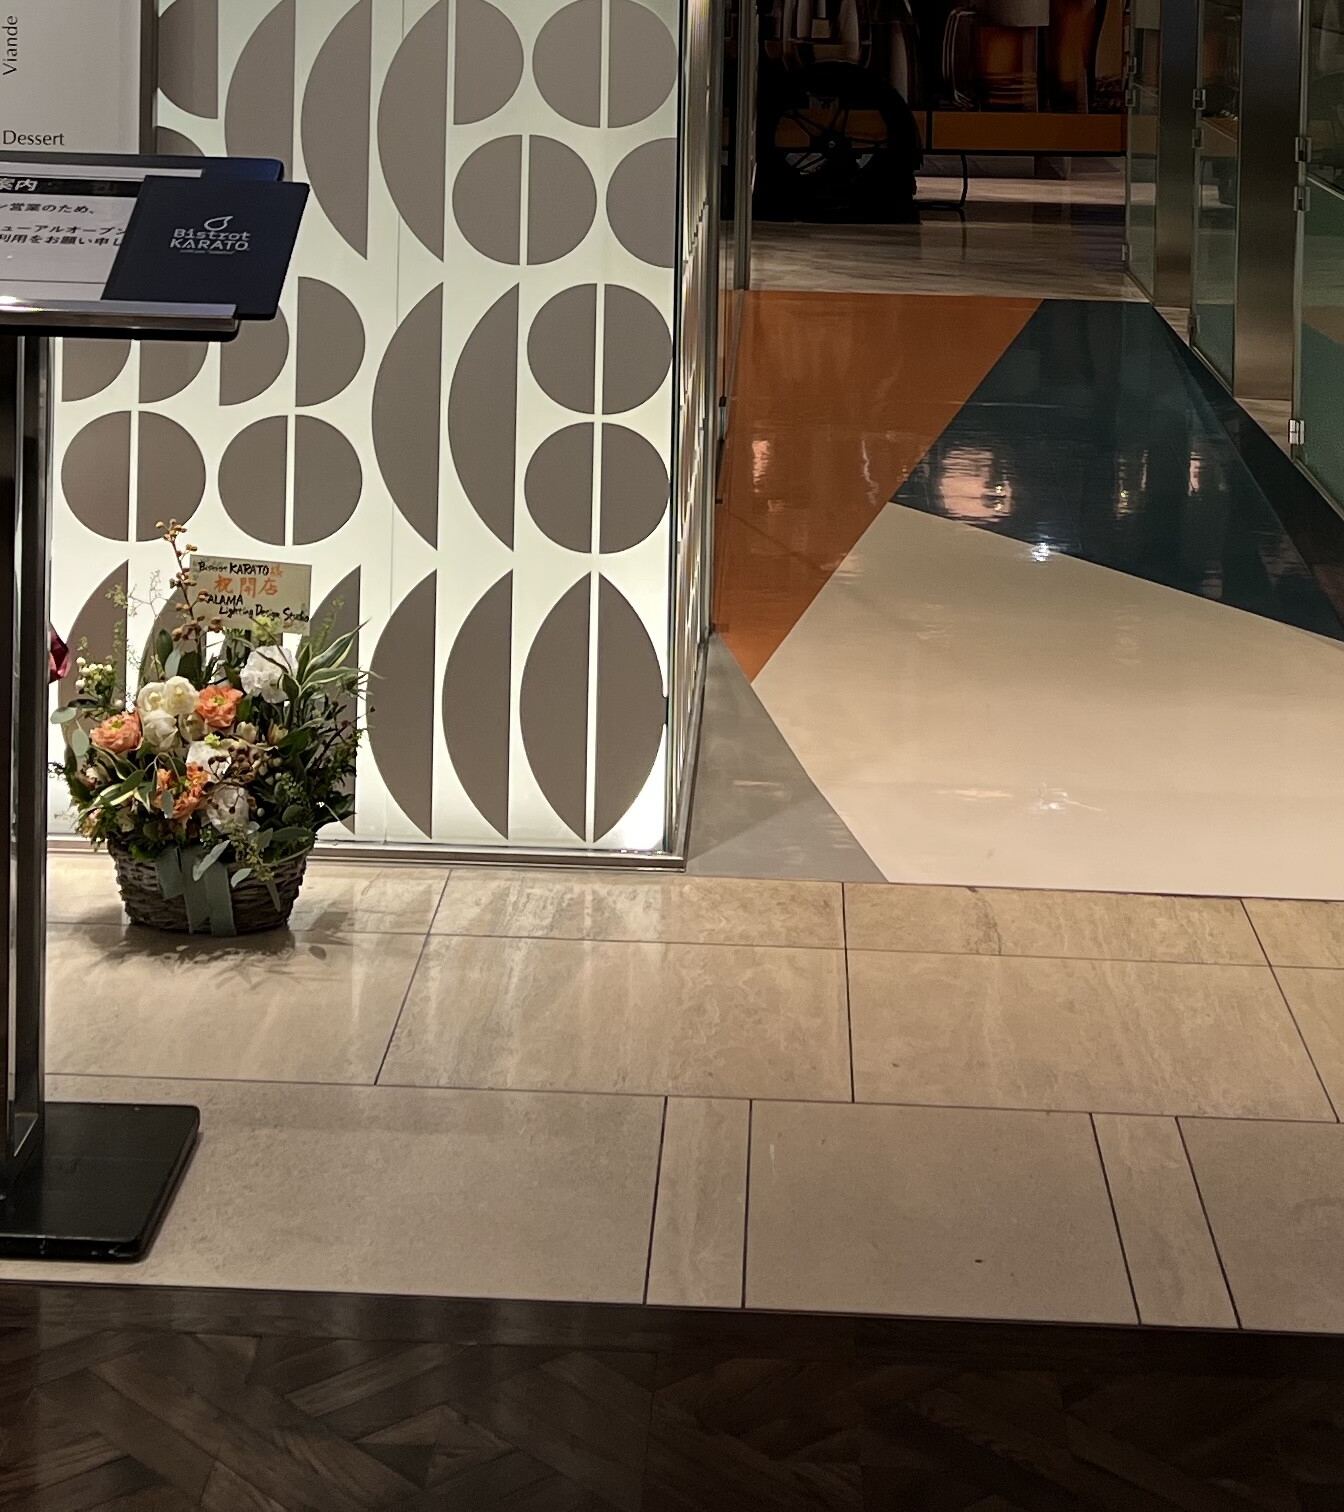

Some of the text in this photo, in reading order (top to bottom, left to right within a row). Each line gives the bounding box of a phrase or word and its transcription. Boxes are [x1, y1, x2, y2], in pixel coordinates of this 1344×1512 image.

[1, 14, 19, 77] Viande
[1, 128, 65, 148] Dessert
[172, 228, 251, 241] Bistrot
[169, 238, 249, 251] KARATO
